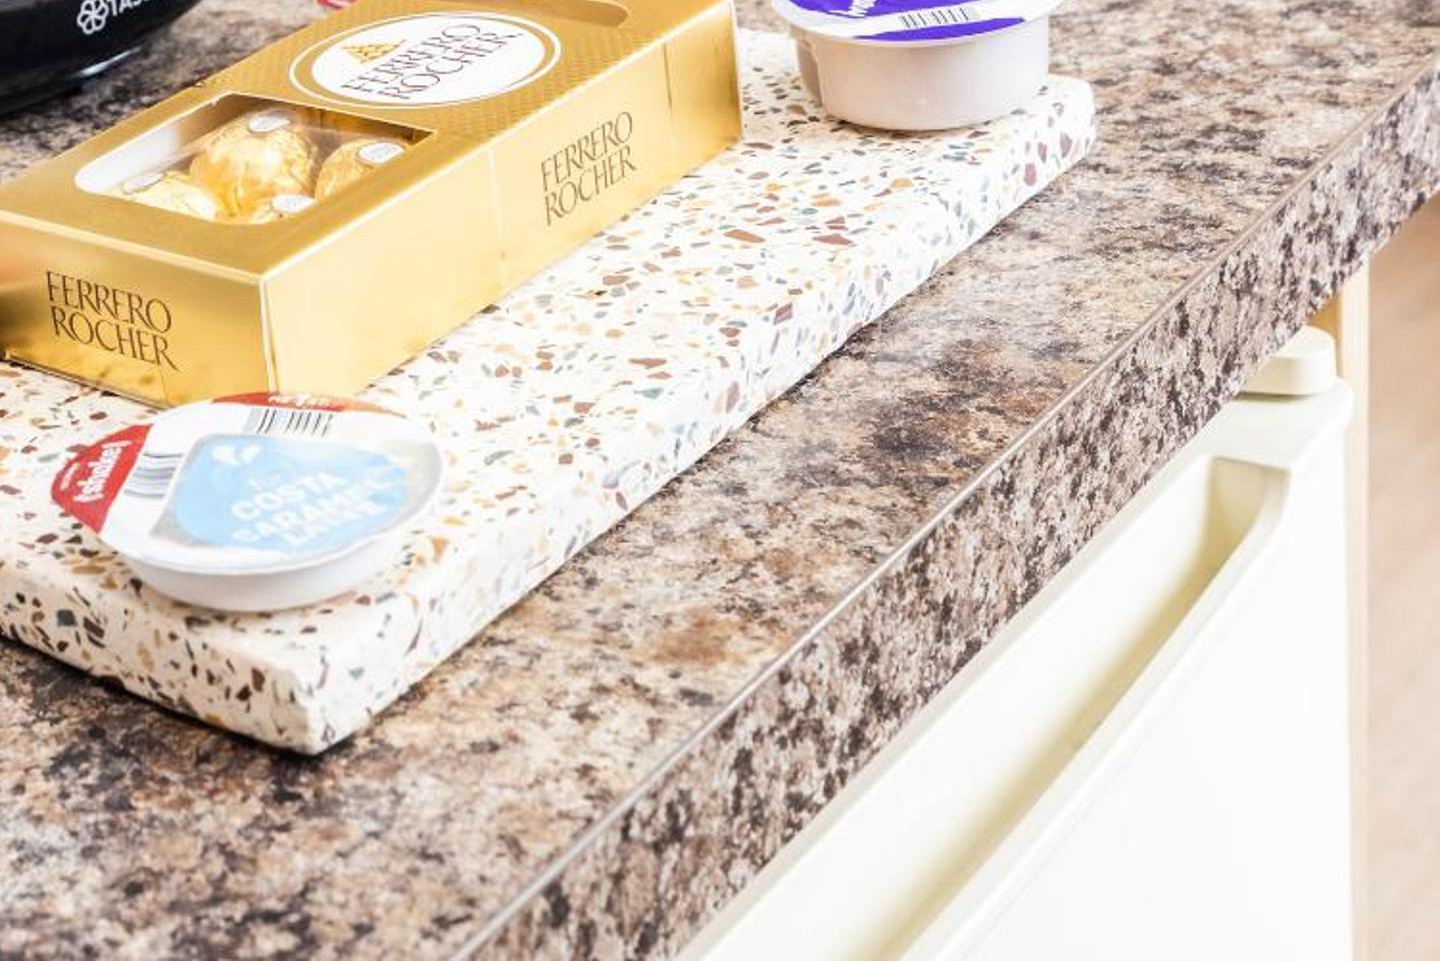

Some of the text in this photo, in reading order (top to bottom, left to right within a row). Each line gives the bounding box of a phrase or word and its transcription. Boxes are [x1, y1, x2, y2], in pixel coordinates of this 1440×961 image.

[341, 24, 481, 92] FERRERO
[377, 32, 524, 99] ROCHER
[541, 111, 633, 192] FERRERO
[545, 144, 637, 226] ROCHER
[46, 270, 173, 334] FERRERO
[51, 305, 181, 373] ROCHER
[231, 471, 347, 521] COSTA
